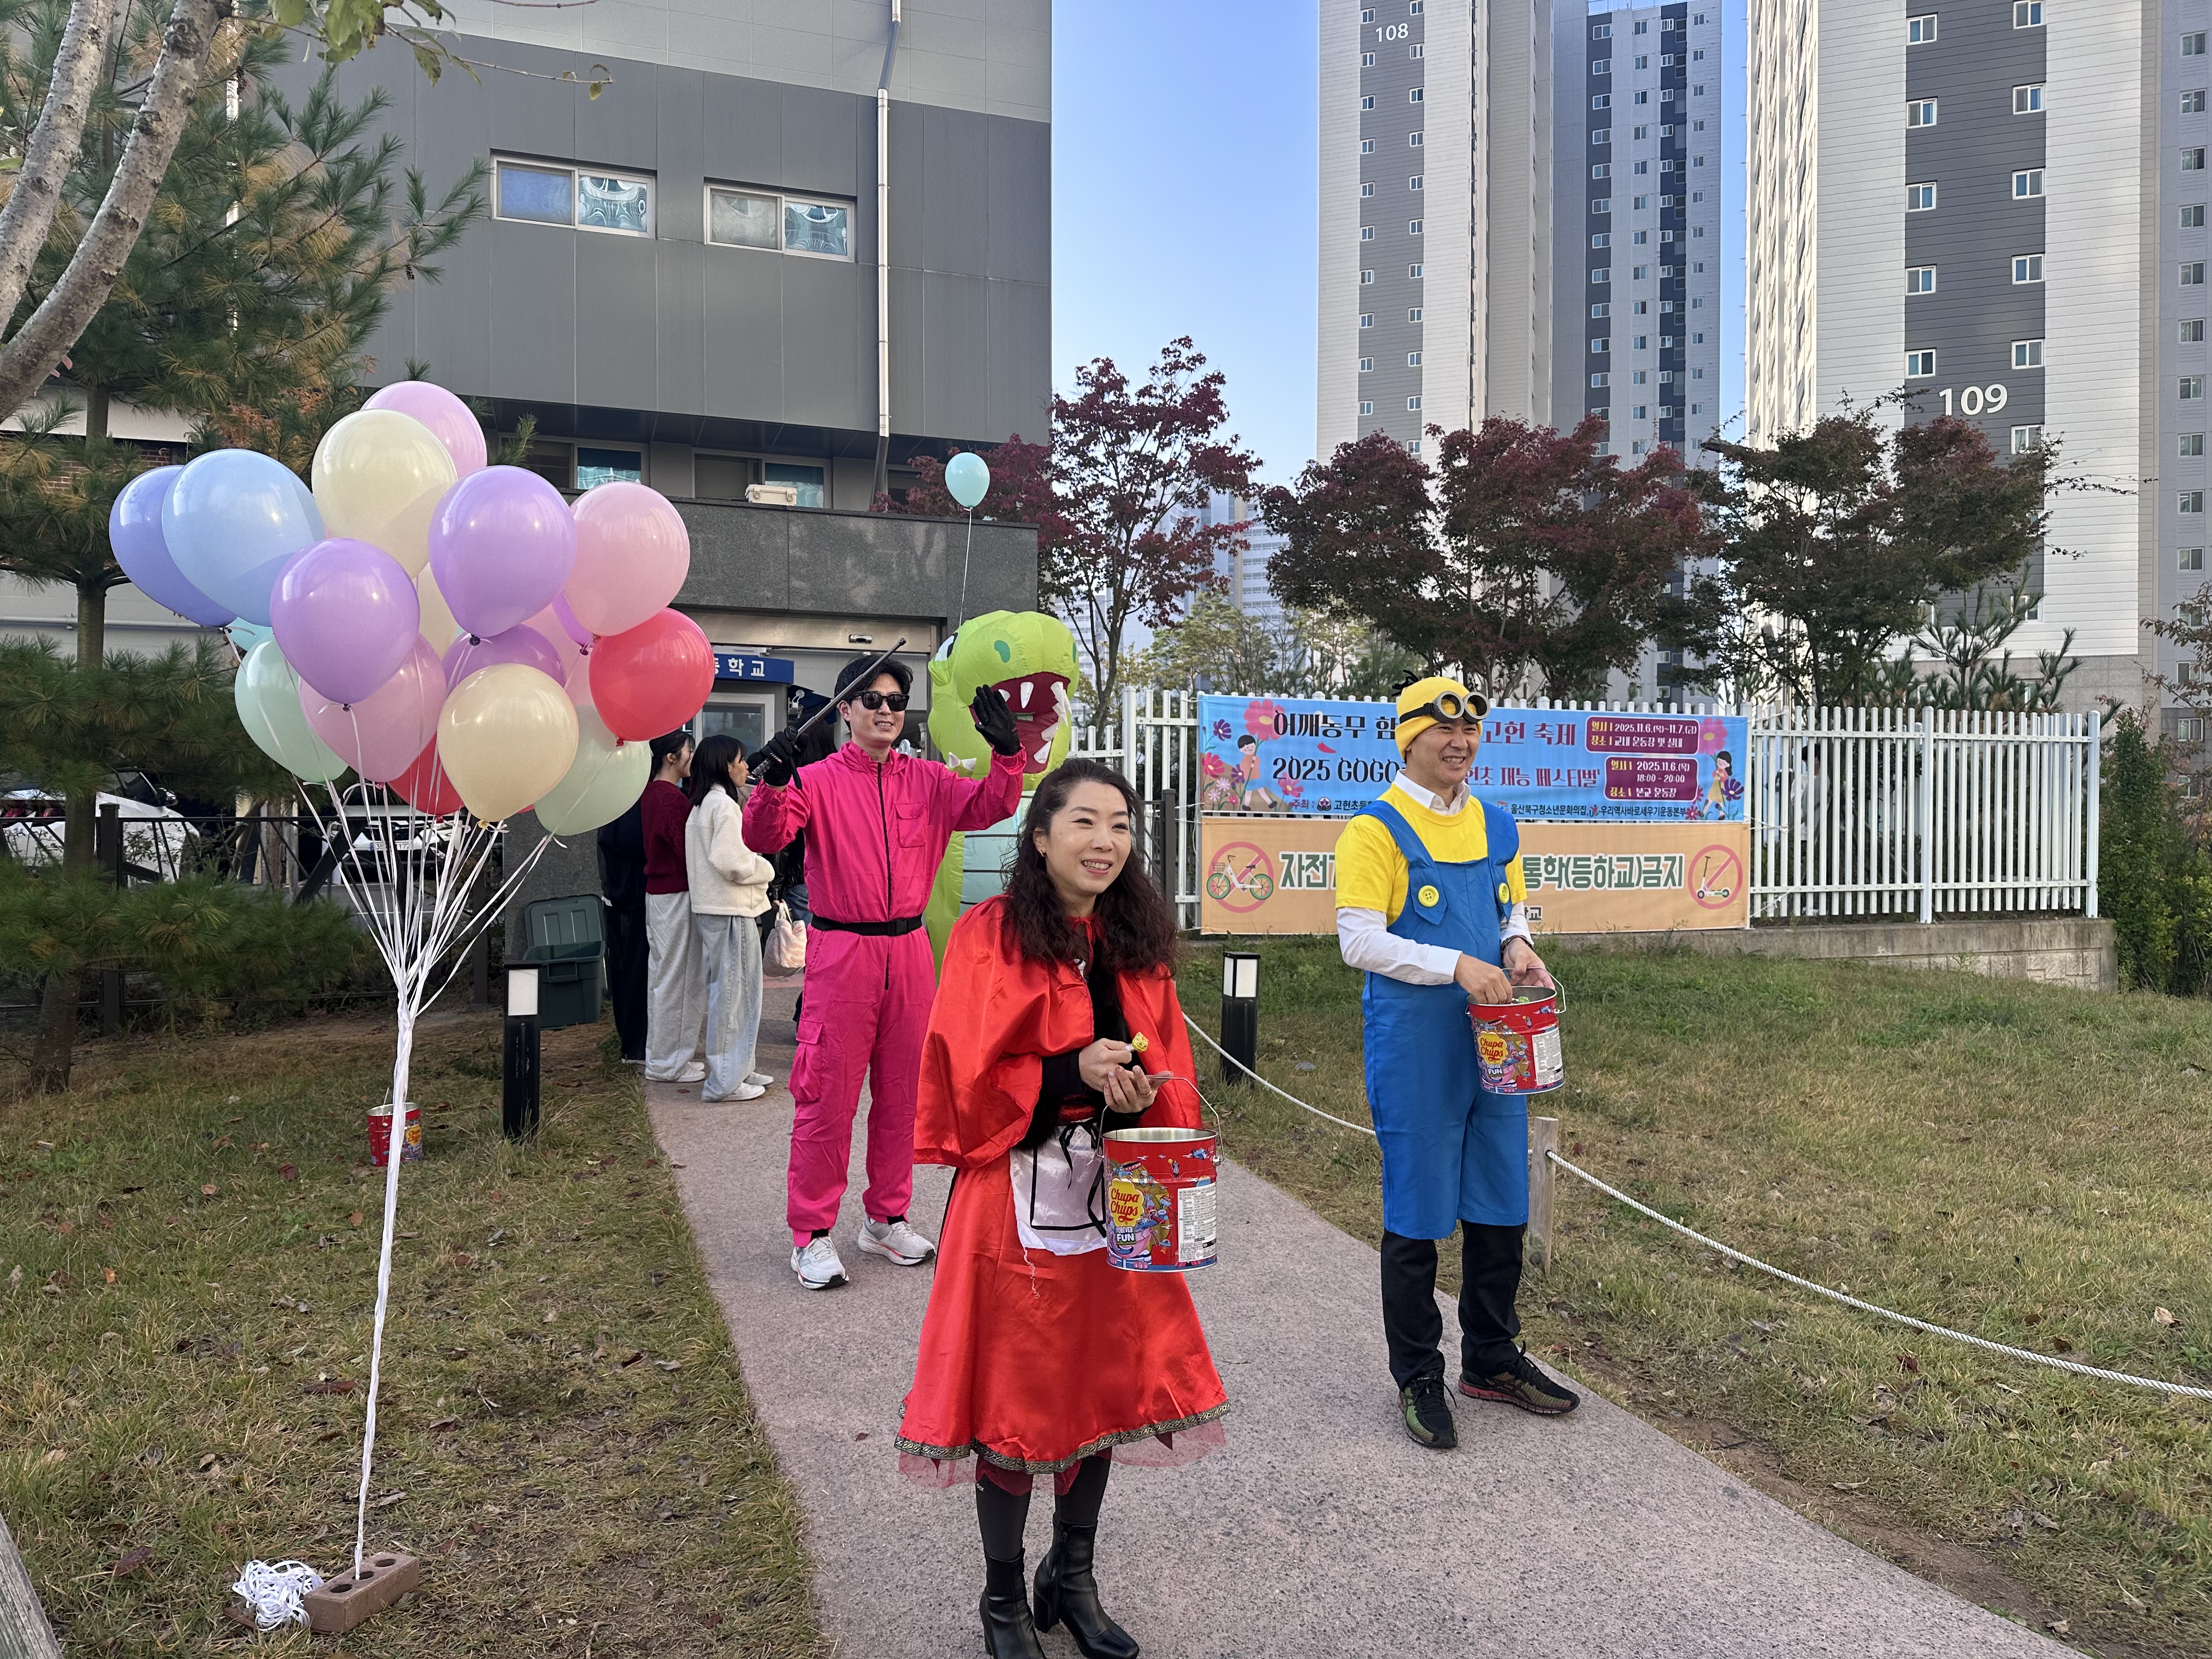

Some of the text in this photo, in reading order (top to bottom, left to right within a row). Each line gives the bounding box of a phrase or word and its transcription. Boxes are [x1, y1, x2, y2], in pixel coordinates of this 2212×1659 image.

[1376, 23, 1408, 42] 108
[1939, 384, 2007, 415] 109
[1274, 710, 1367, 738] 어깨동무
[1481, 721, 1525, 744] 고헌
[1533, 723, 1576, 746] 축제
[1592, 720, 1607, 732] 일시
[1591, 735, 1606, 746] 장소
[1615, 736, 1630, 746] 교내
[1633, 736, 1655, 747] 운동장
[1658, 737, 1665, 748] 및
[1668, 737, 1683, 748] 실내
[1273, 756, 1330, 781] 2025
[1500, 767, 1530, 786] 재능
[1611, 759, 1627, 770] 일시
[1637, 760, 1690, 772] 2025.11.6.(목)
[1637, 774, 1656, 782] 18:00
[1663, 774, 1685, 783] 20:00
[1610, 787, 1626, 797] 장소
[1636, 787, 1651, 797] 본교
[1654, 787, 1677, 798] 운동장
[1293, 799, 1309, 810] 주최
[1334, 800, 1372, 811] 고헌초등
[1601, 805, 1686, 817] 우리역사바로세우기운동본부
[1480, 1038, 1503, 1049] Chupa
[1481, 1046, 1503, 1061] Chups
[1111, 1188, 1139, 1205] Chupa
[1110, 1200, 1138, 1222] Chups
[1117, 1233, 1135, 1242] FUN
